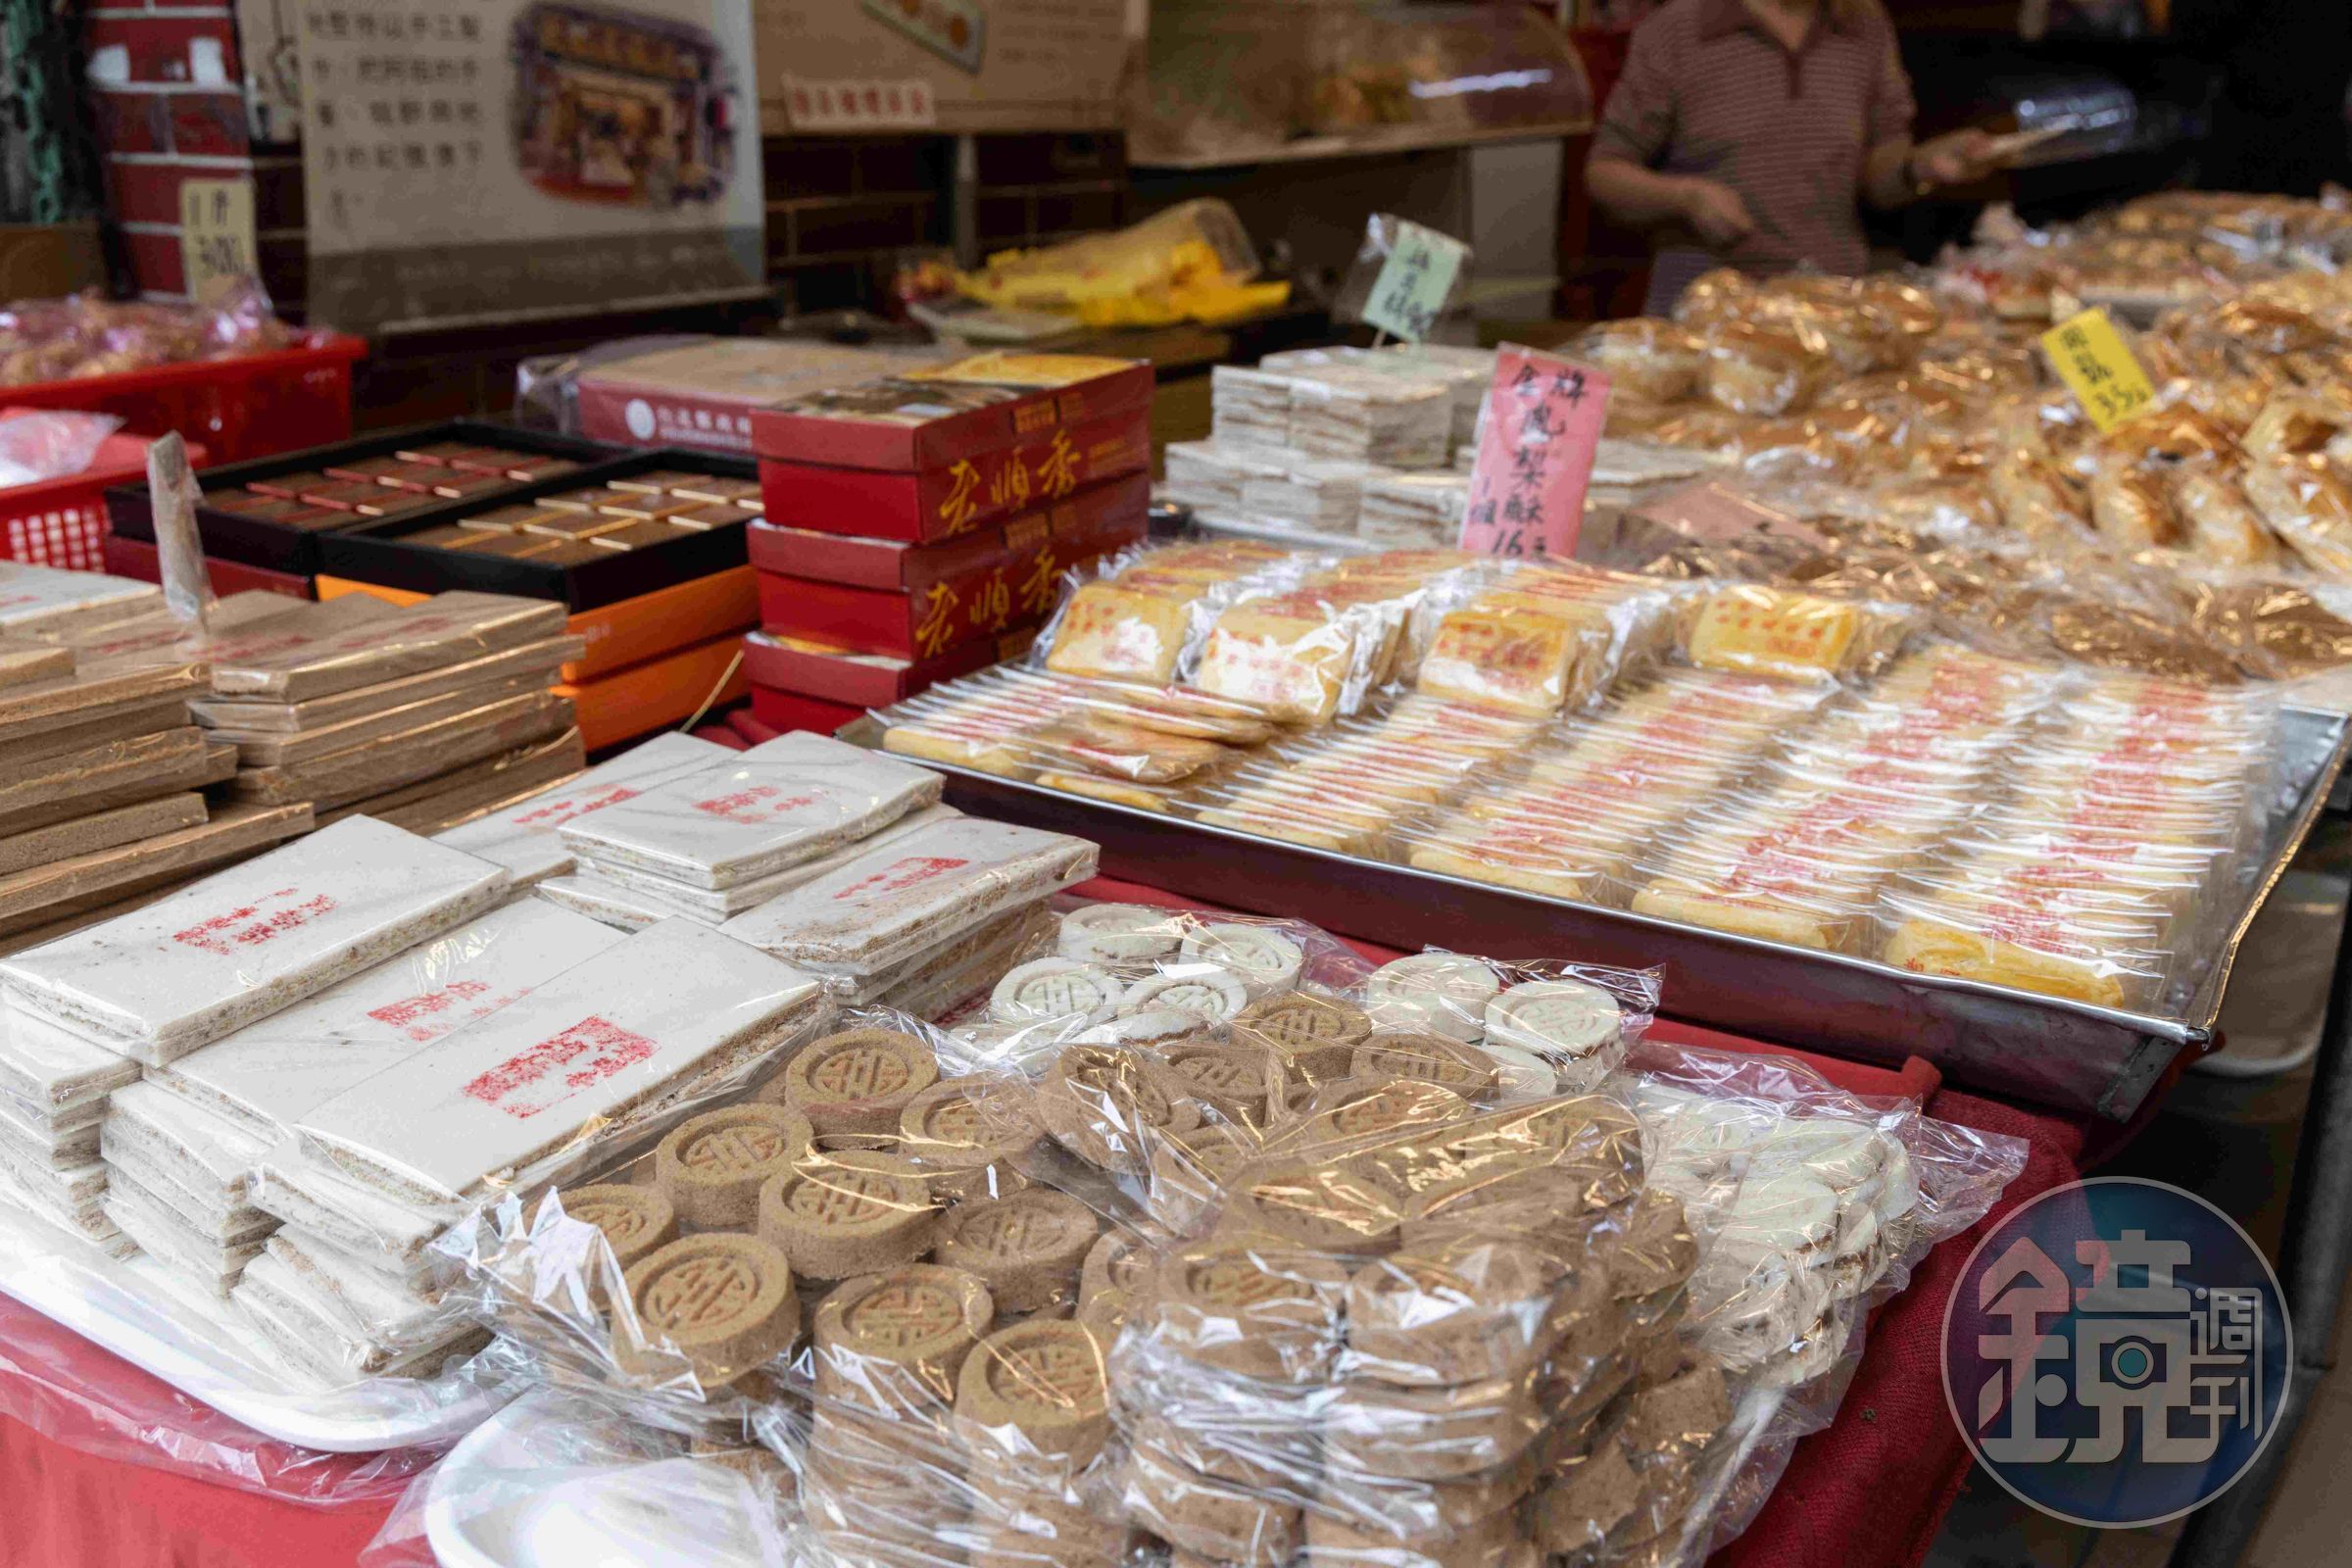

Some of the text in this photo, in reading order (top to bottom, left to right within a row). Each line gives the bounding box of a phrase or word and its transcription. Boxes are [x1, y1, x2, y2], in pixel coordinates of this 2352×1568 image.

[939, 428, 1082, 536] 老順香
[914, 546, 1065, 659] 老順香
